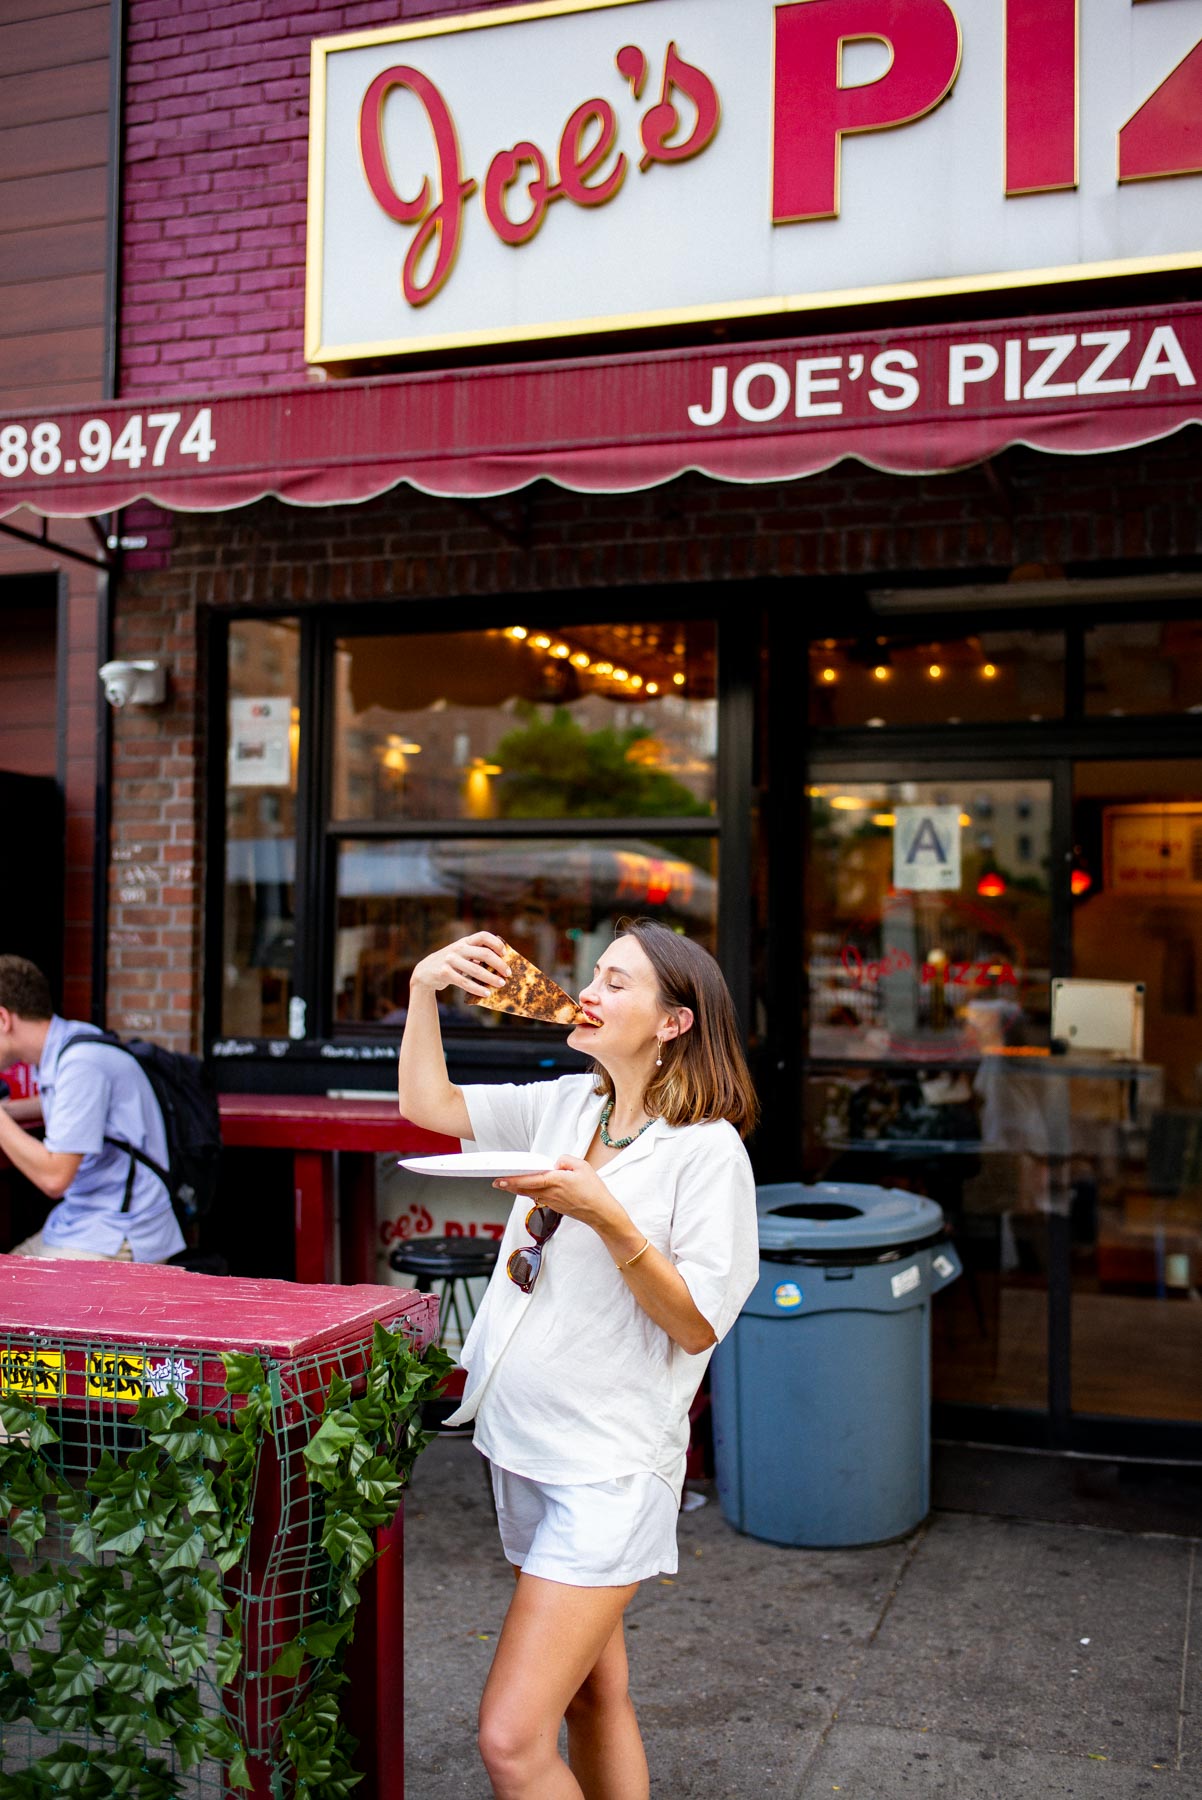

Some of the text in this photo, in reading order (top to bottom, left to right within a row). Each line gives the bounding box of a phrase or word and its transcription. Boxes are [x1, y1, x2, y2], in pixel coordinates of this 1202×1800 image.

[359, 41, 721, 308] Joe's
[687, 325, 1197, 427] JOE'S PIZZA
[0, 408, 217, 478] 88.9474
[905, 817, 948, 864] A
[921, 962, 1018, 986] PIZZA
